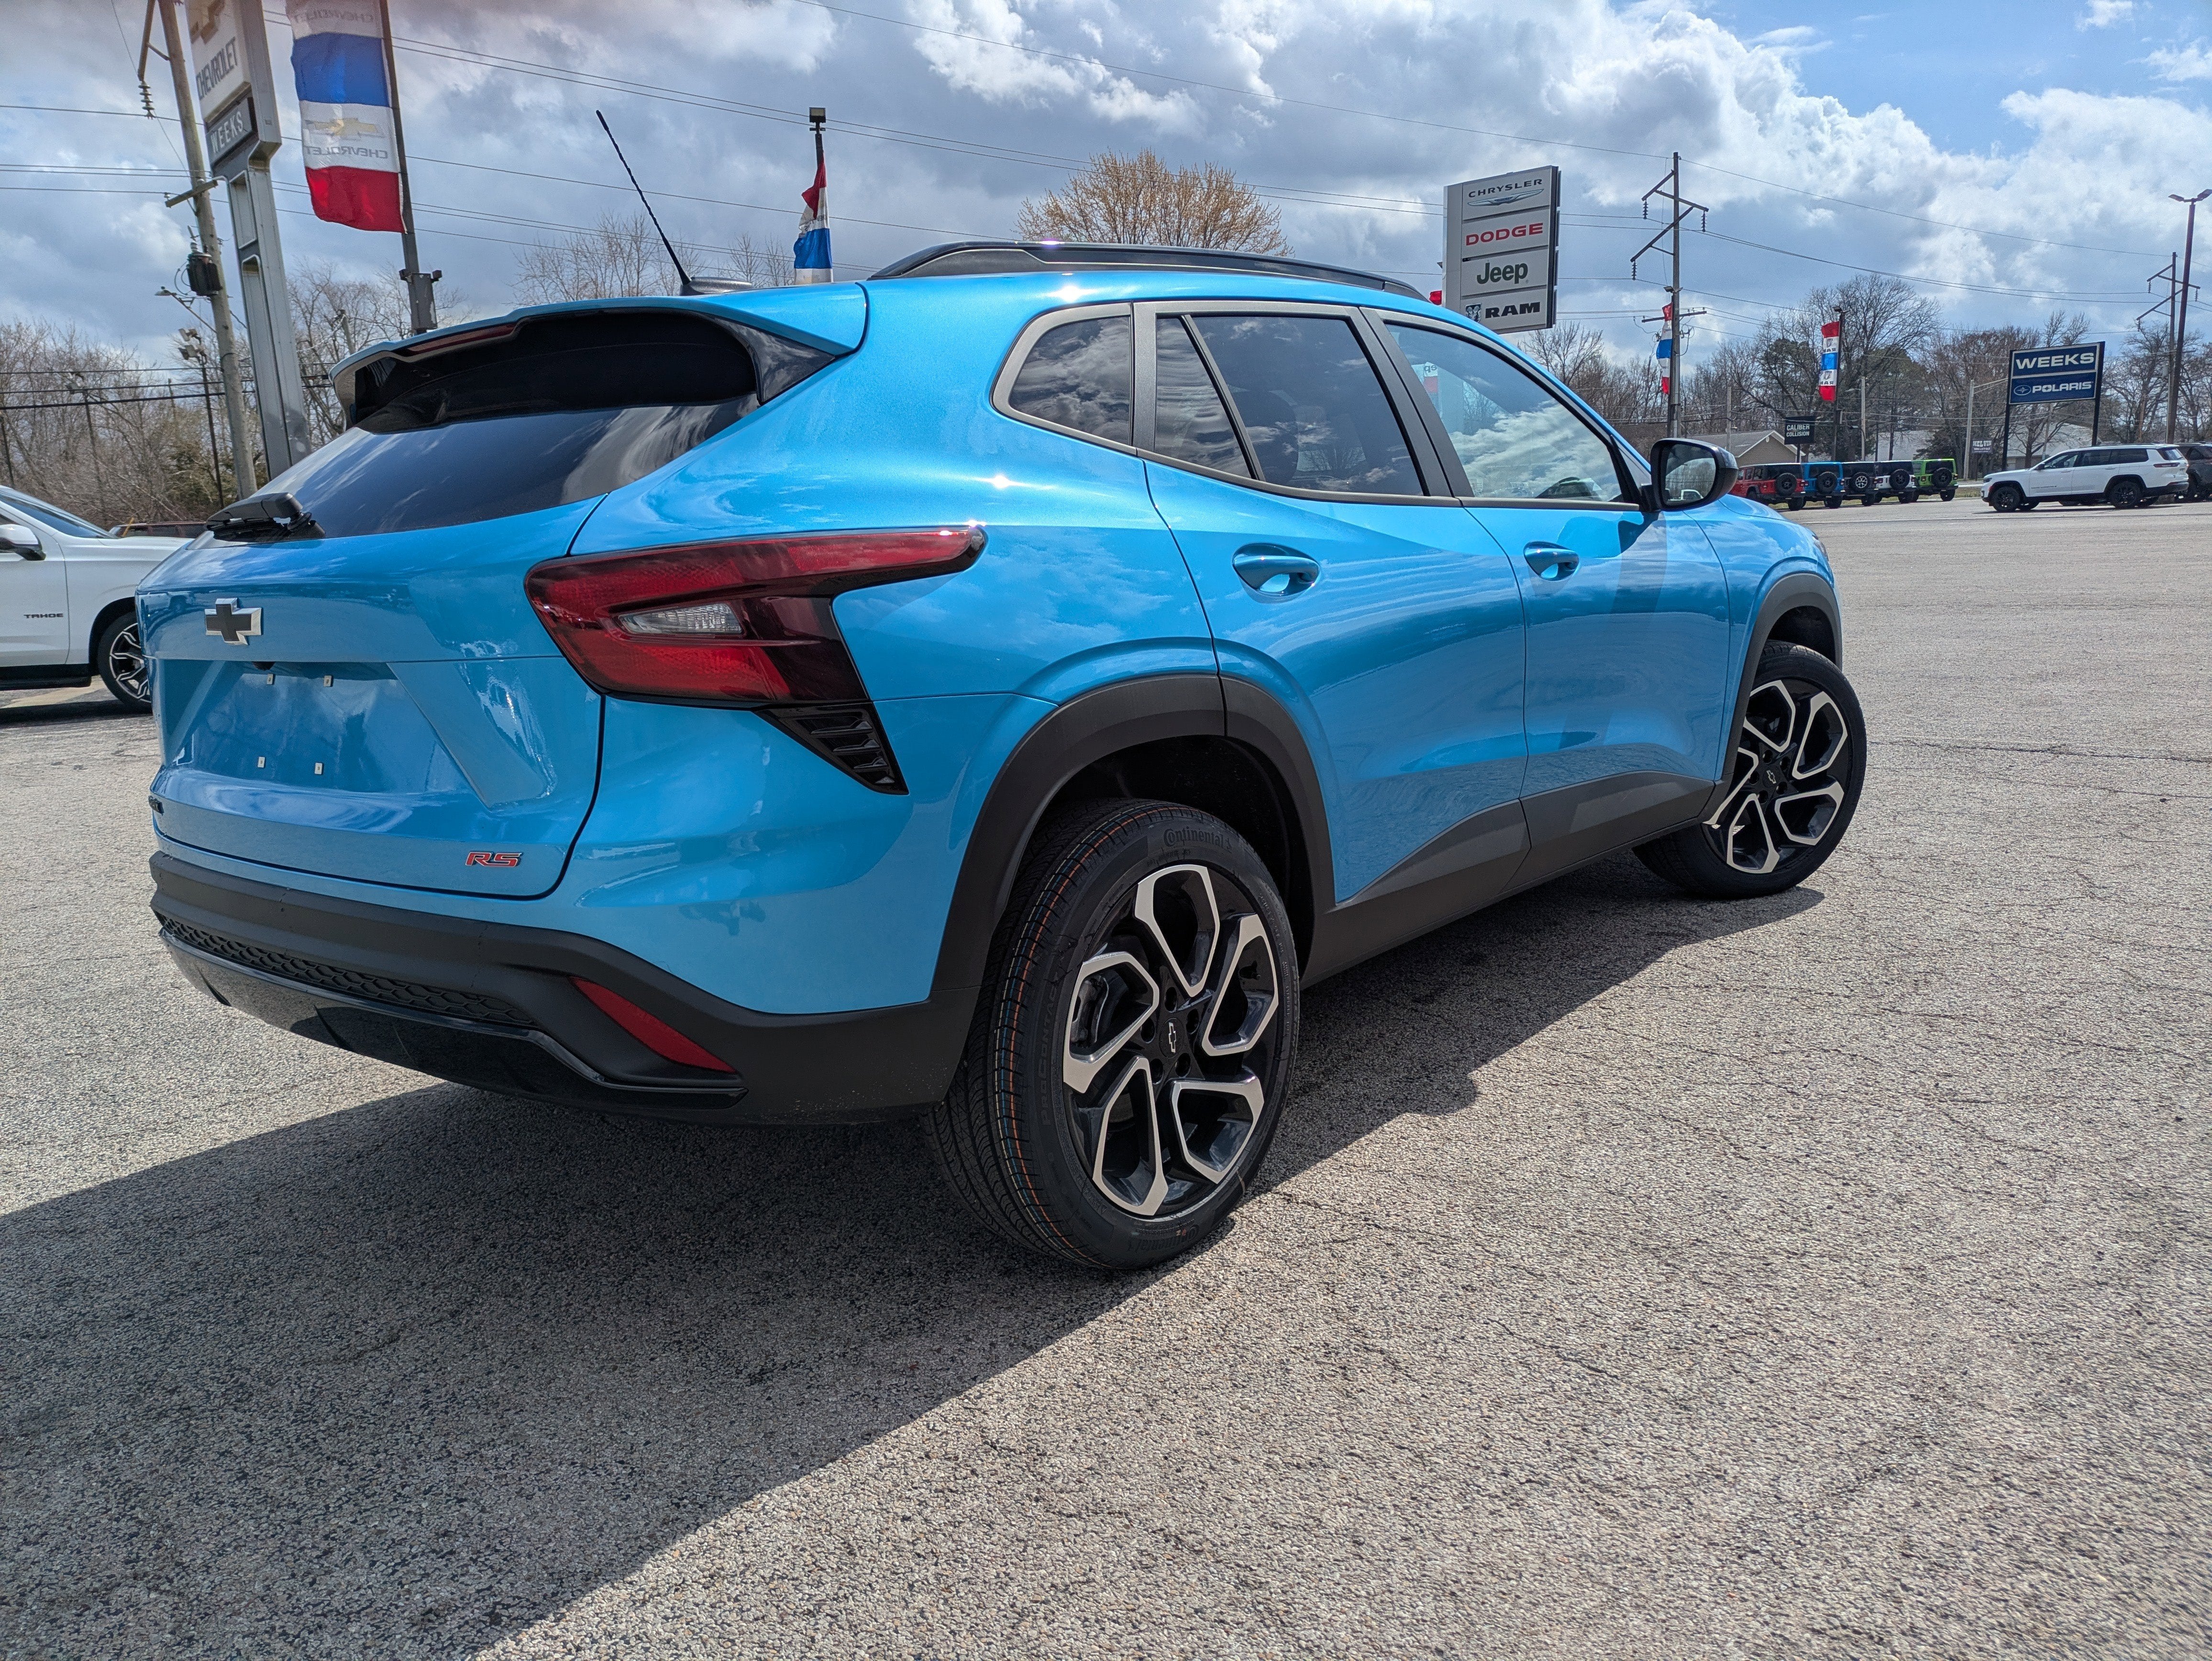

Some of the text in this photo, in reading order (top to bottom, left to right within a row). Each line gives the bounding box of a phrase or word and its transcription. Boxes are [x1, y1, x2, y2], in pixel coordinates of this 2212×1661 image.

[196, 36, 238, 100] CHEVROLET
[210, 111, 243, 153] WEEKS
[1468, 178, 1542, 198] CHRYSLER
[1466, 222, 1543, 246] DODGE
[1477, 262, 1528, 284] Jeep
[1485, 301, 1540, 319] RAM
[2015, 353, 2094, 369] WEEKS
[2032, 381, 2092, 393] POLARIS
[1163, 826, 1223, 849] Continental
[465, 851, 523, 867] RS
